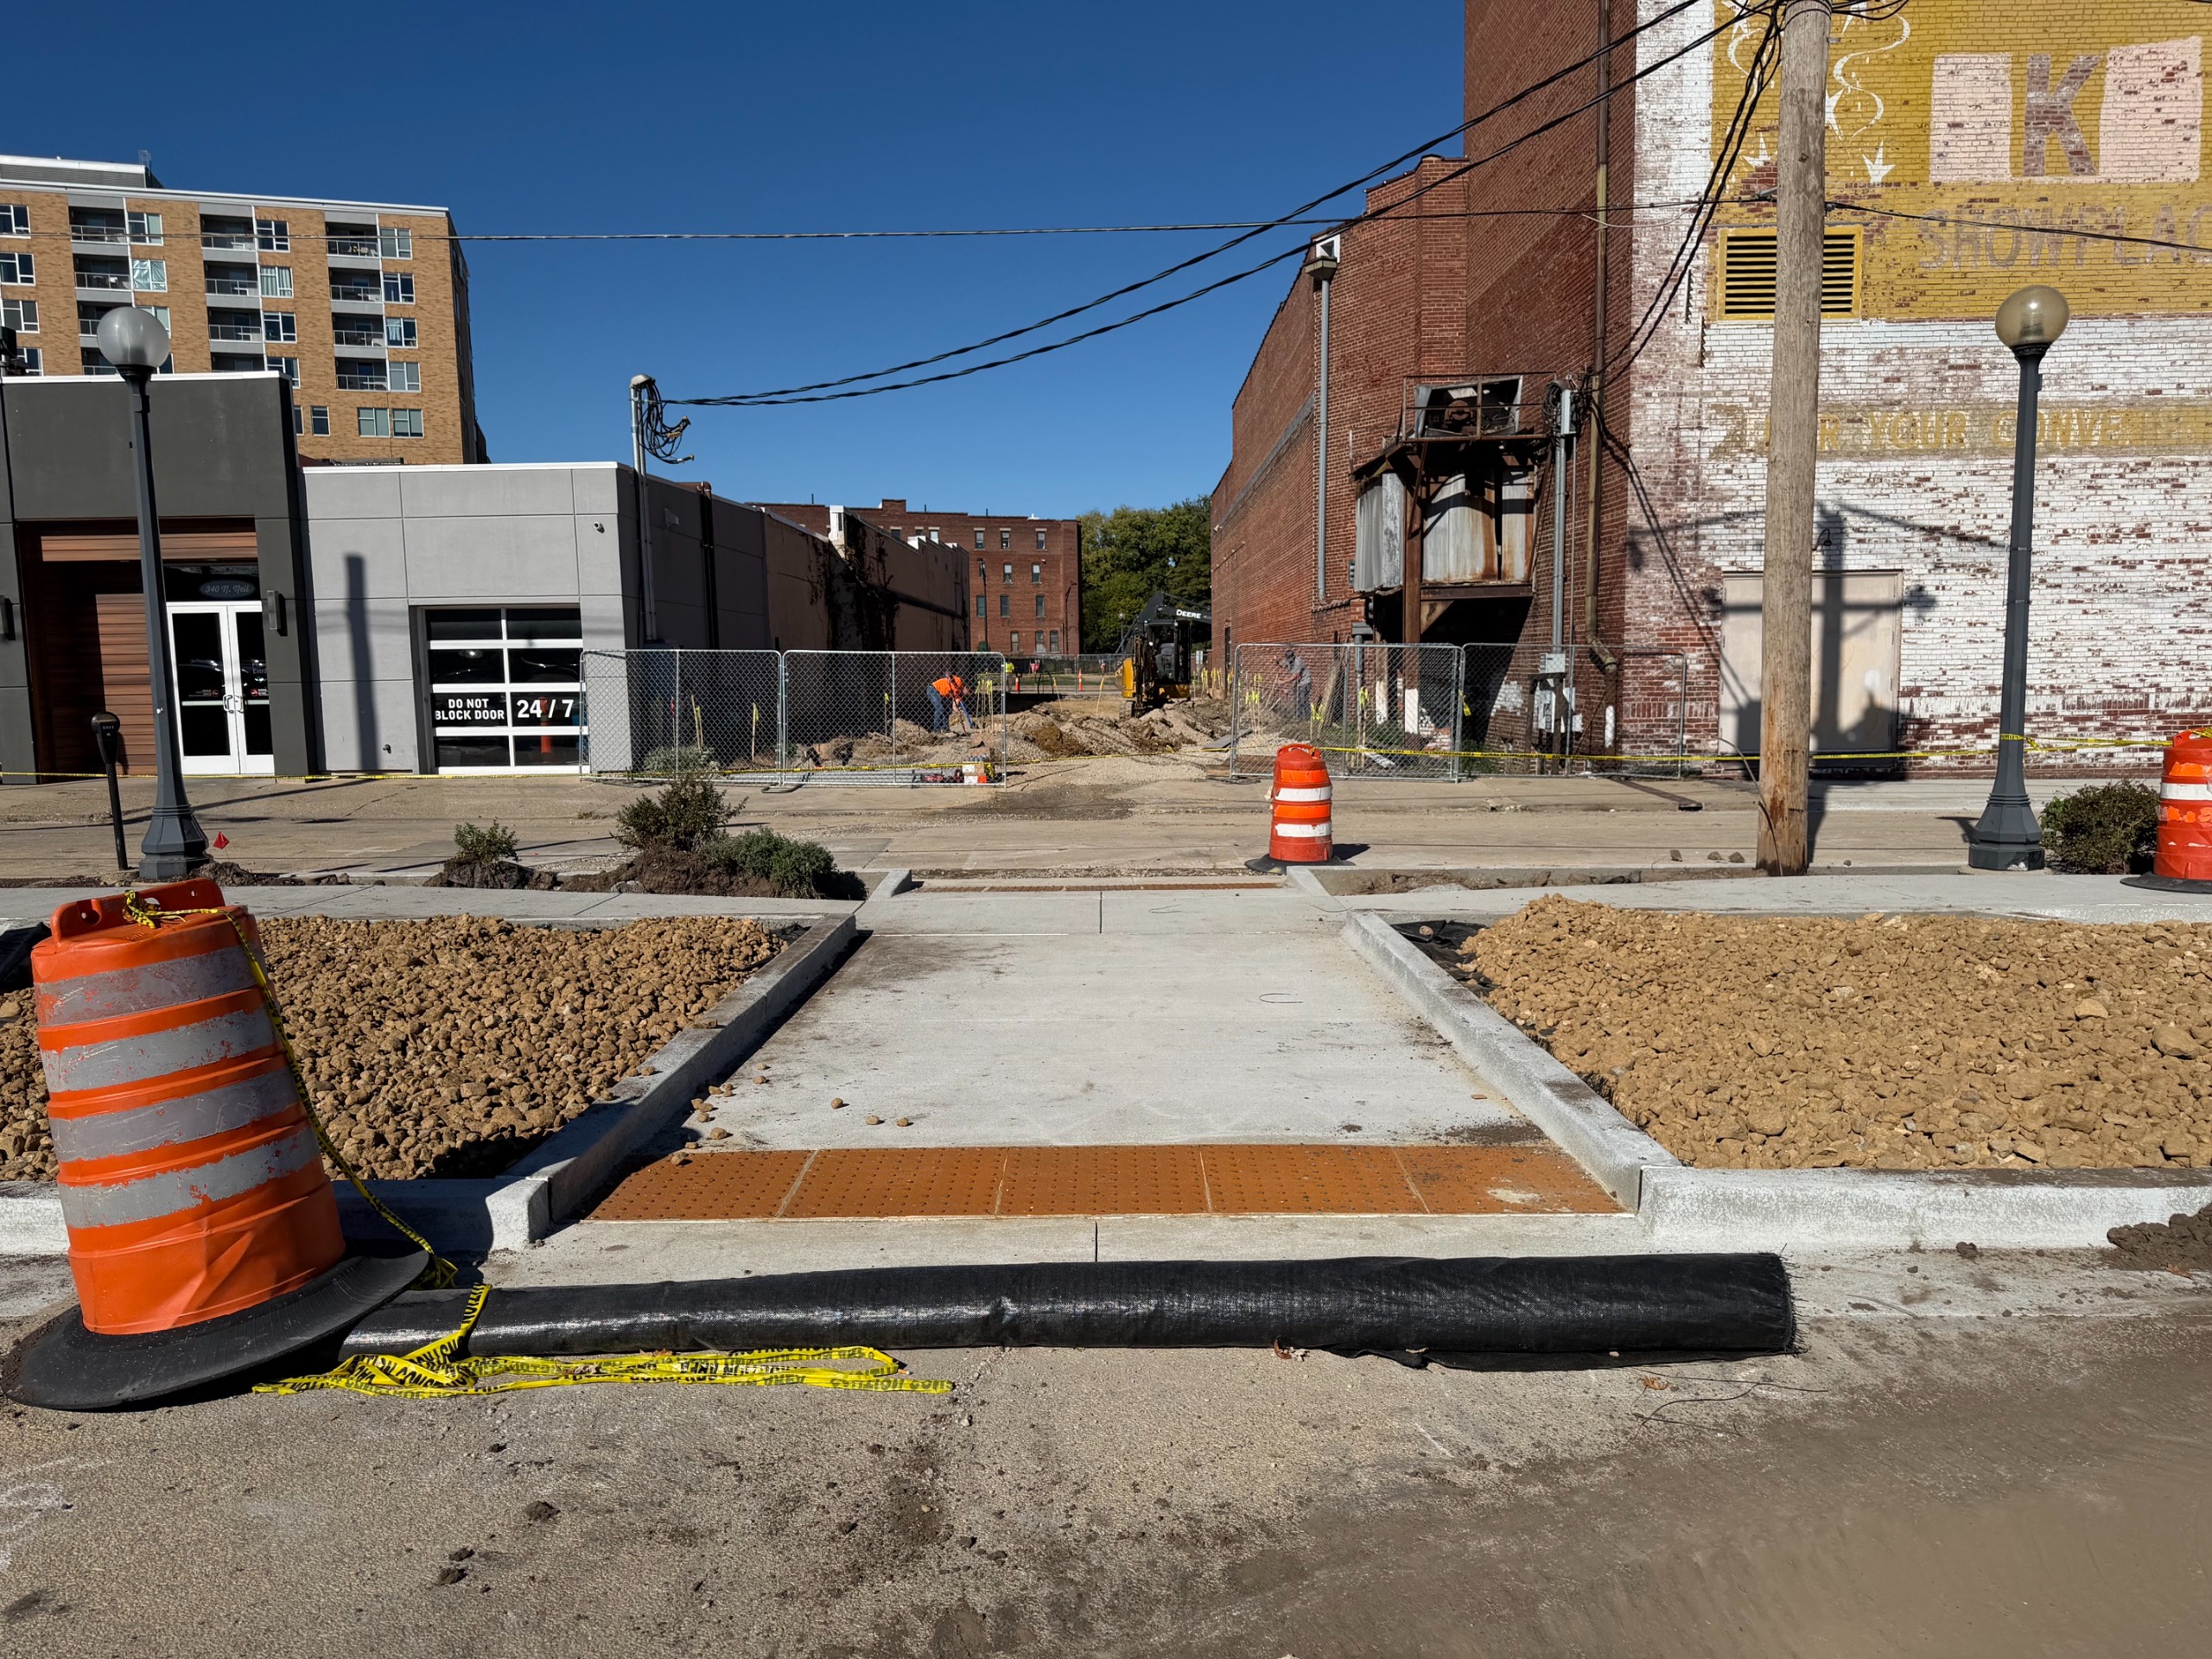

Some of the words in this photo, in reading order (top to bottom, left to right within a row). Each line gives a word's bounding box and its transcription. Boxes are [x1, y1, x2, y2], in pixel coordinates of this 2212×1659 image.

[2023, 54, 2103, 176] K
[1866, 410, 1967, 449] YOUR
[206, 585, 219, 594] 340
[232, 584, 250, 594] Neil
[1176, 608, 1202, 619] DEERE
[448, 698, 463, 709] DO
[467, 698, 489, 709] NOT
[435, 710, 472, 720] BLOCK
[475, 709, 505, 720] DOOR
